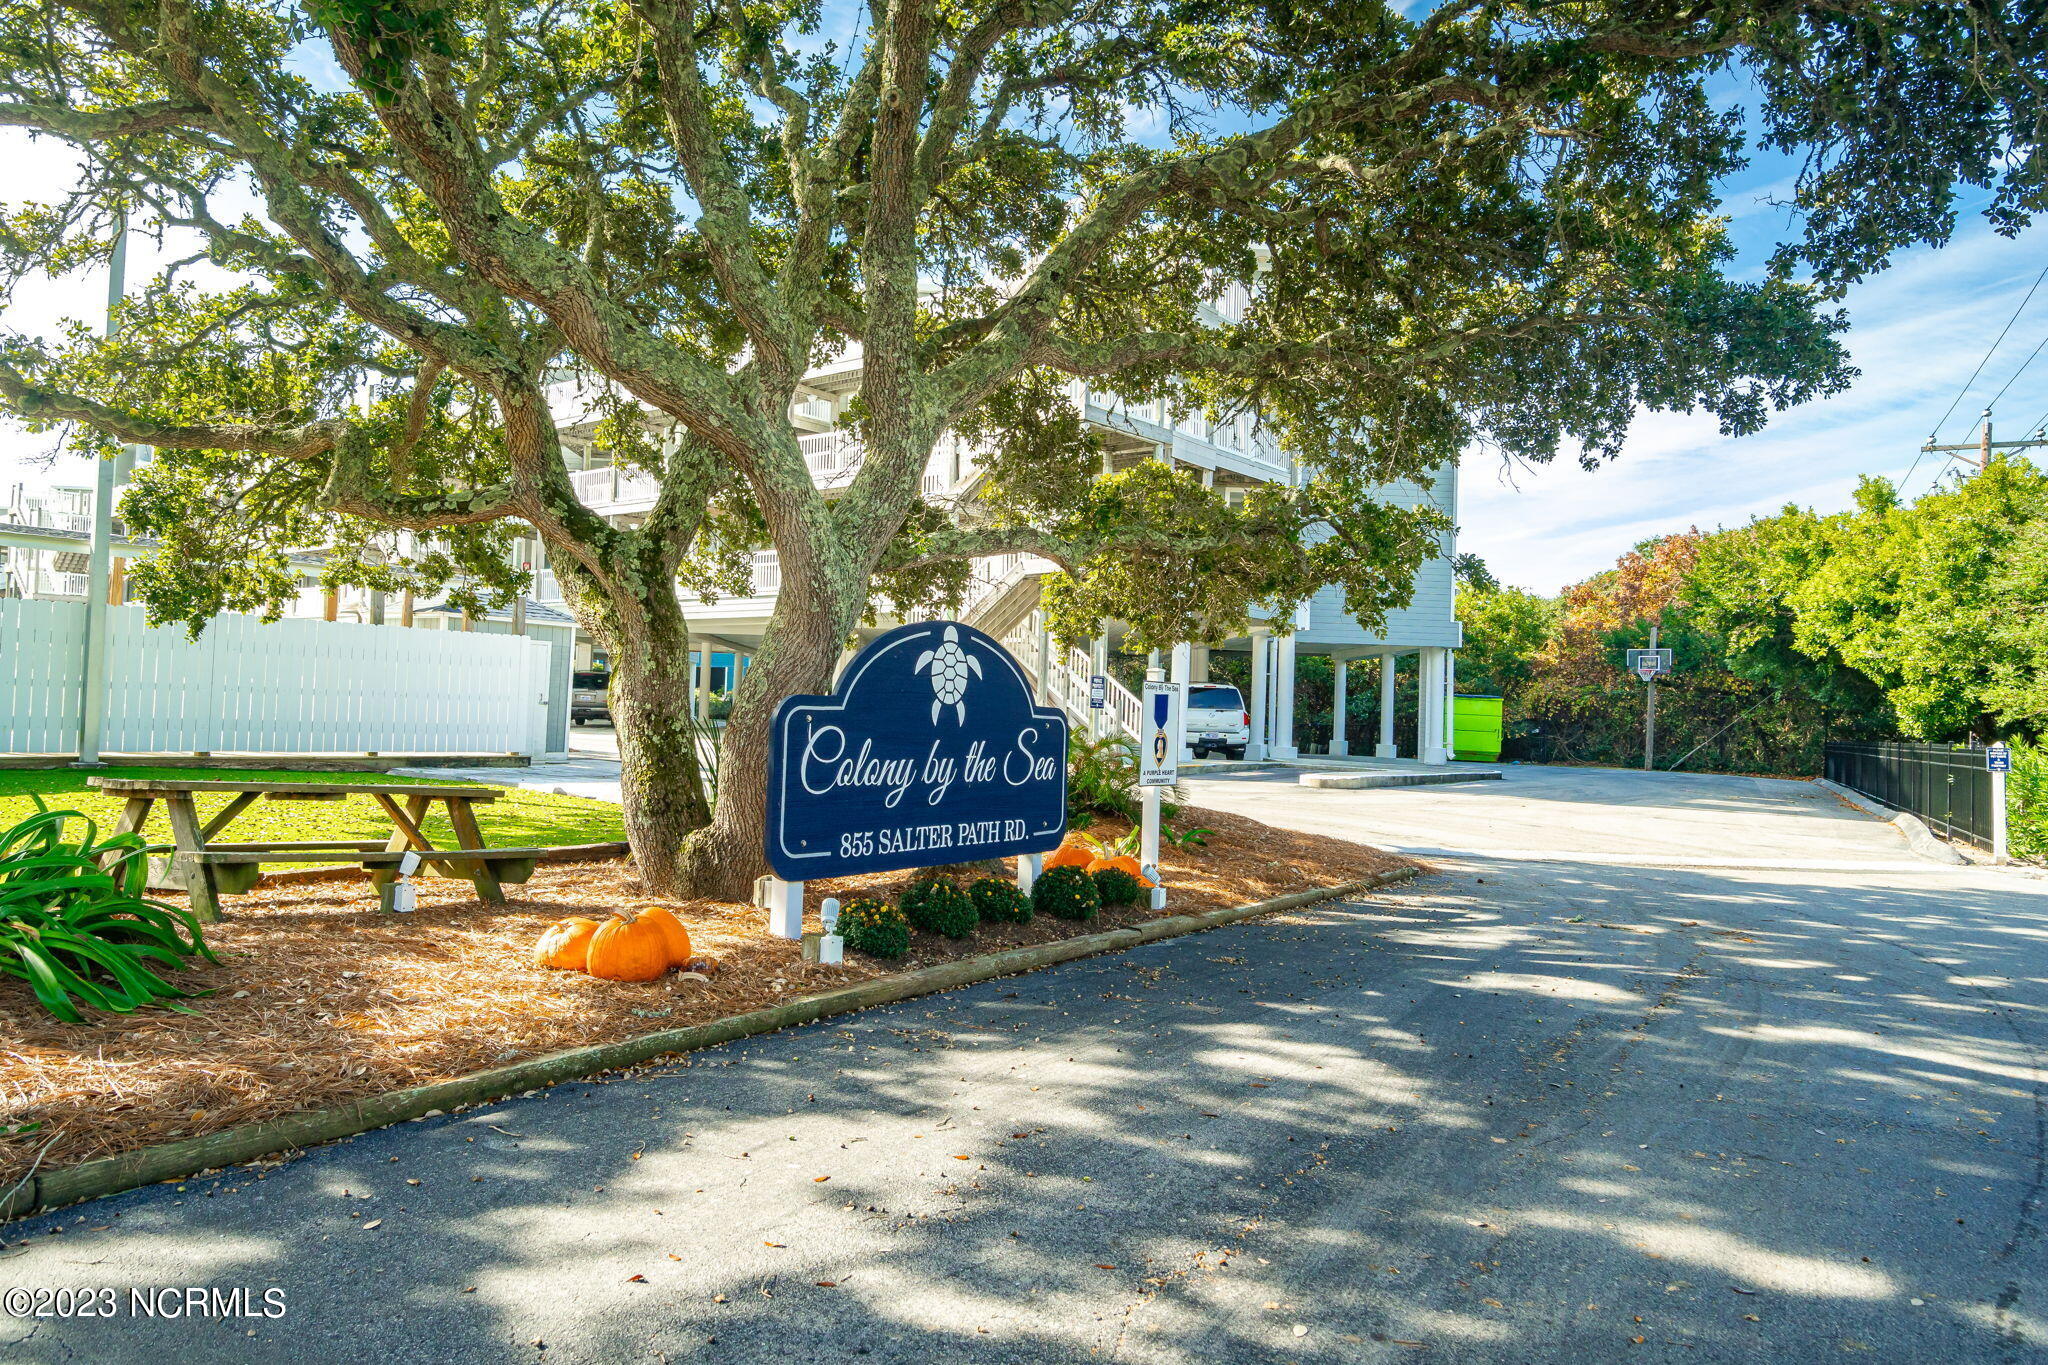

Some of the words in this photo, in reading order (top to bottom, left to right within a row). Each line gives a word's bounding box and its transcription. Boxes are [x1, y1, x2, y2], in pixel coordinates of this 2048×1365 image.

[802, 724, 917, 809] Colony
[921, 739, 957, 806] by
[964, 740, 997, 783] the
[1003, 728, 1056, 786] Sea
[840, 832, 874, 858] 855
[878, 824, 953, 854] SALTER
[957, 822, 1001, 845] PATH
[1004, 819, 1029, 842] RD.
